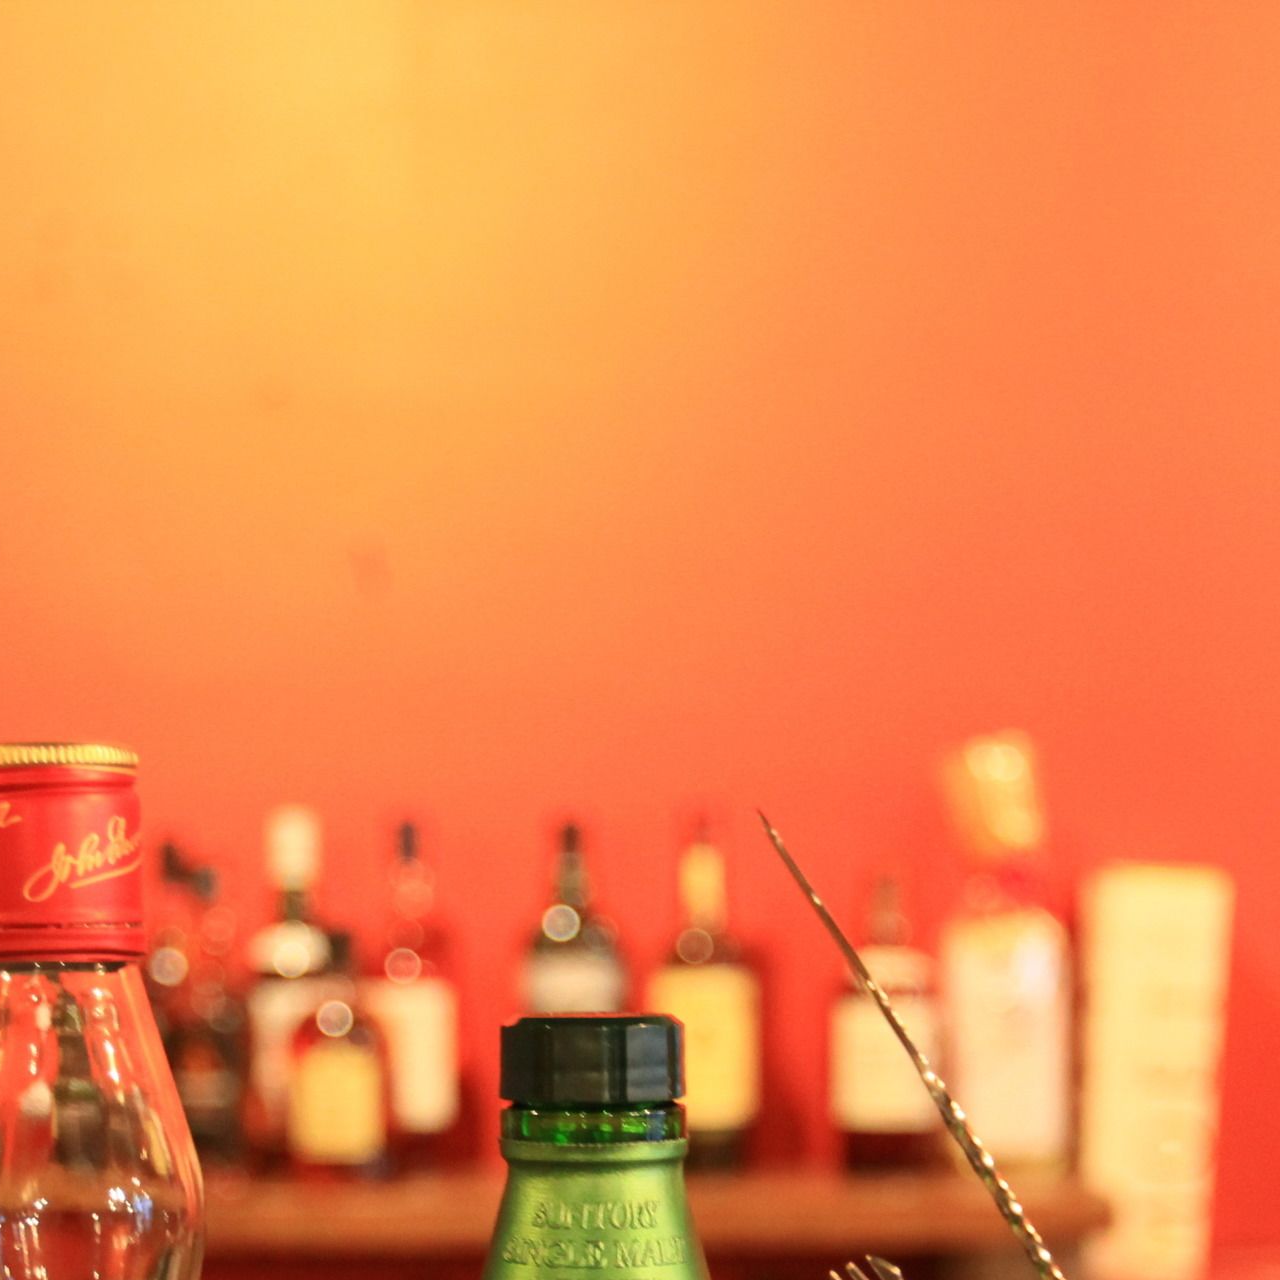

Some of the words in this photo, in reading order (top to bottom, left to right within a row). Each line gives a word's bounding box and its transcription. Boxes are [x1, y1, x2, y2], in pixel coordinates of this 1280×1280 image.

[532, 1200, 659, 1230] SUNTORY
[502, 1235, 608, 1269] SINGLE
[613, 1234, 687, 1269] MALT
